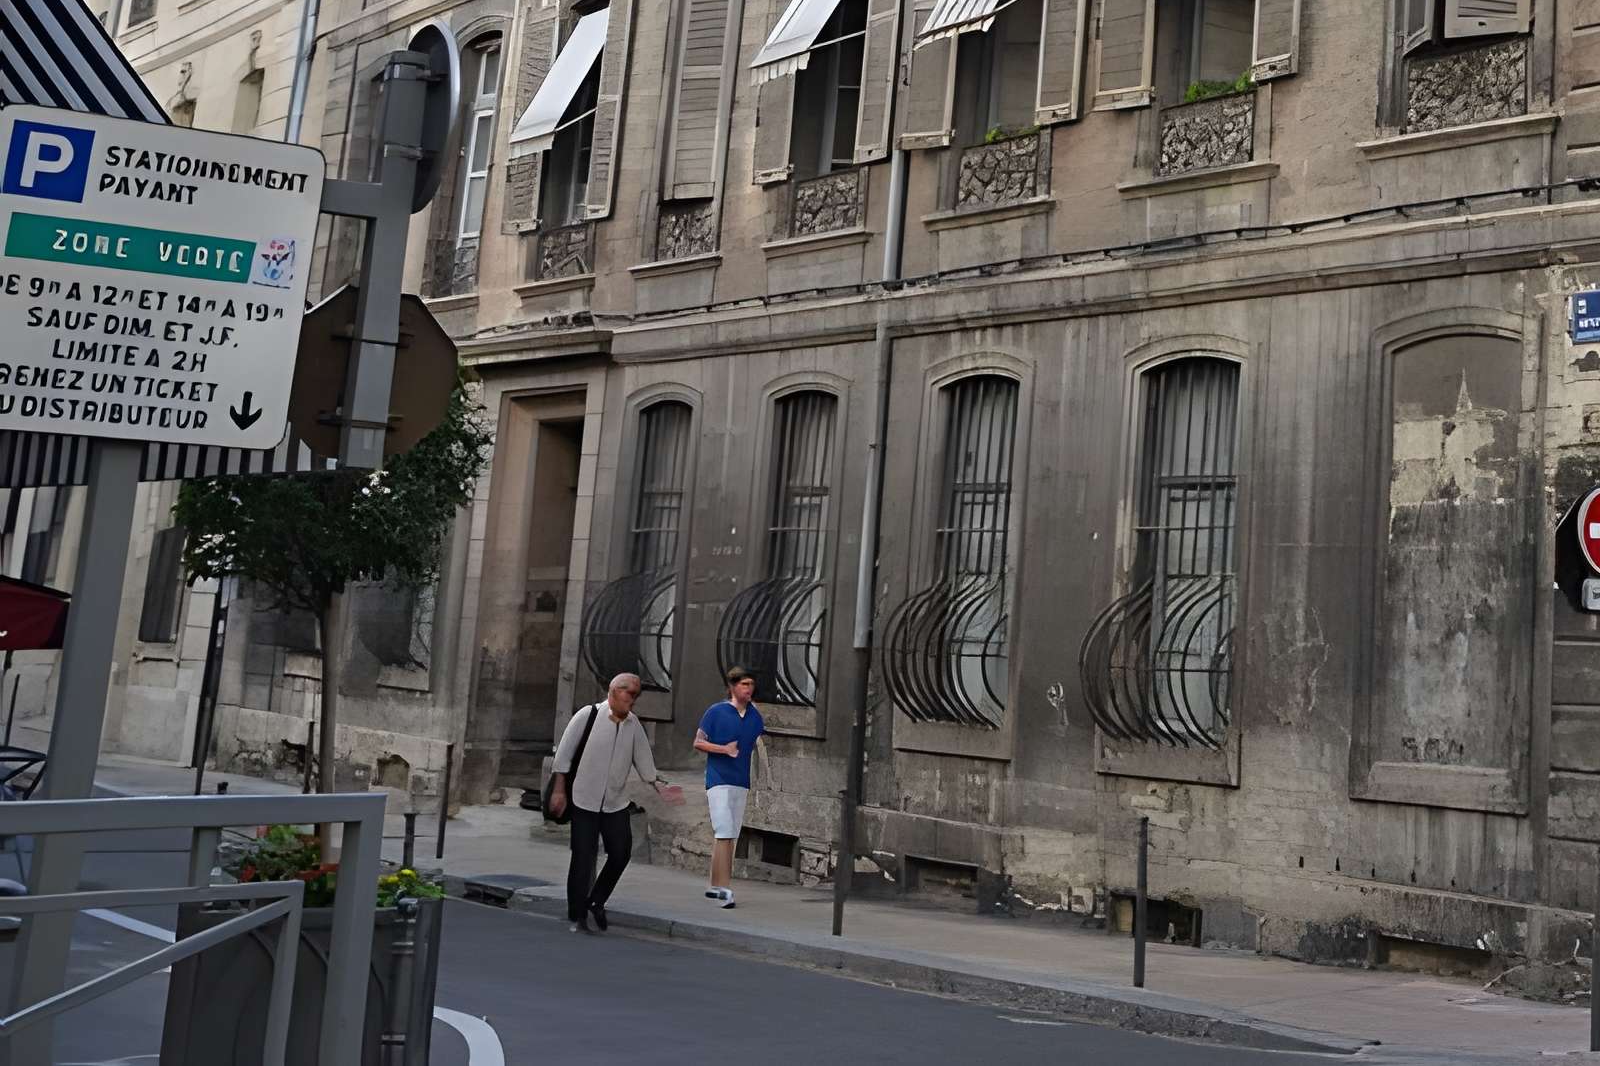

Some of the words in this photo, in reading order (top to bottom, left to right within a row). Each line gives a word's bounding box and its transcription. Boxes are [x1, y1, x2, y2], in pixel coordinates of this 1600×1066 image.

[105, 146, 309, 193] STATIONNEMENT
[99, 173, 198, 204] PAYANT
[52, 229, 132, 258] ZONE
[159, 241, 244, 273] VERTE
[0, 274, 21, 295] E
[138, 289, 168, 311] ET
[27, 307, 98, 330] SAUF
[163, 321, 193, 342] ET
[52, 338, 140, 366] LIMITE
[171, 350, 207, 372] 2H
[91, 373, 127, 393] UN
[134, 376, 219, 402] TICKET
[21, 395, 208, 429] DISTRIBUTEUR
